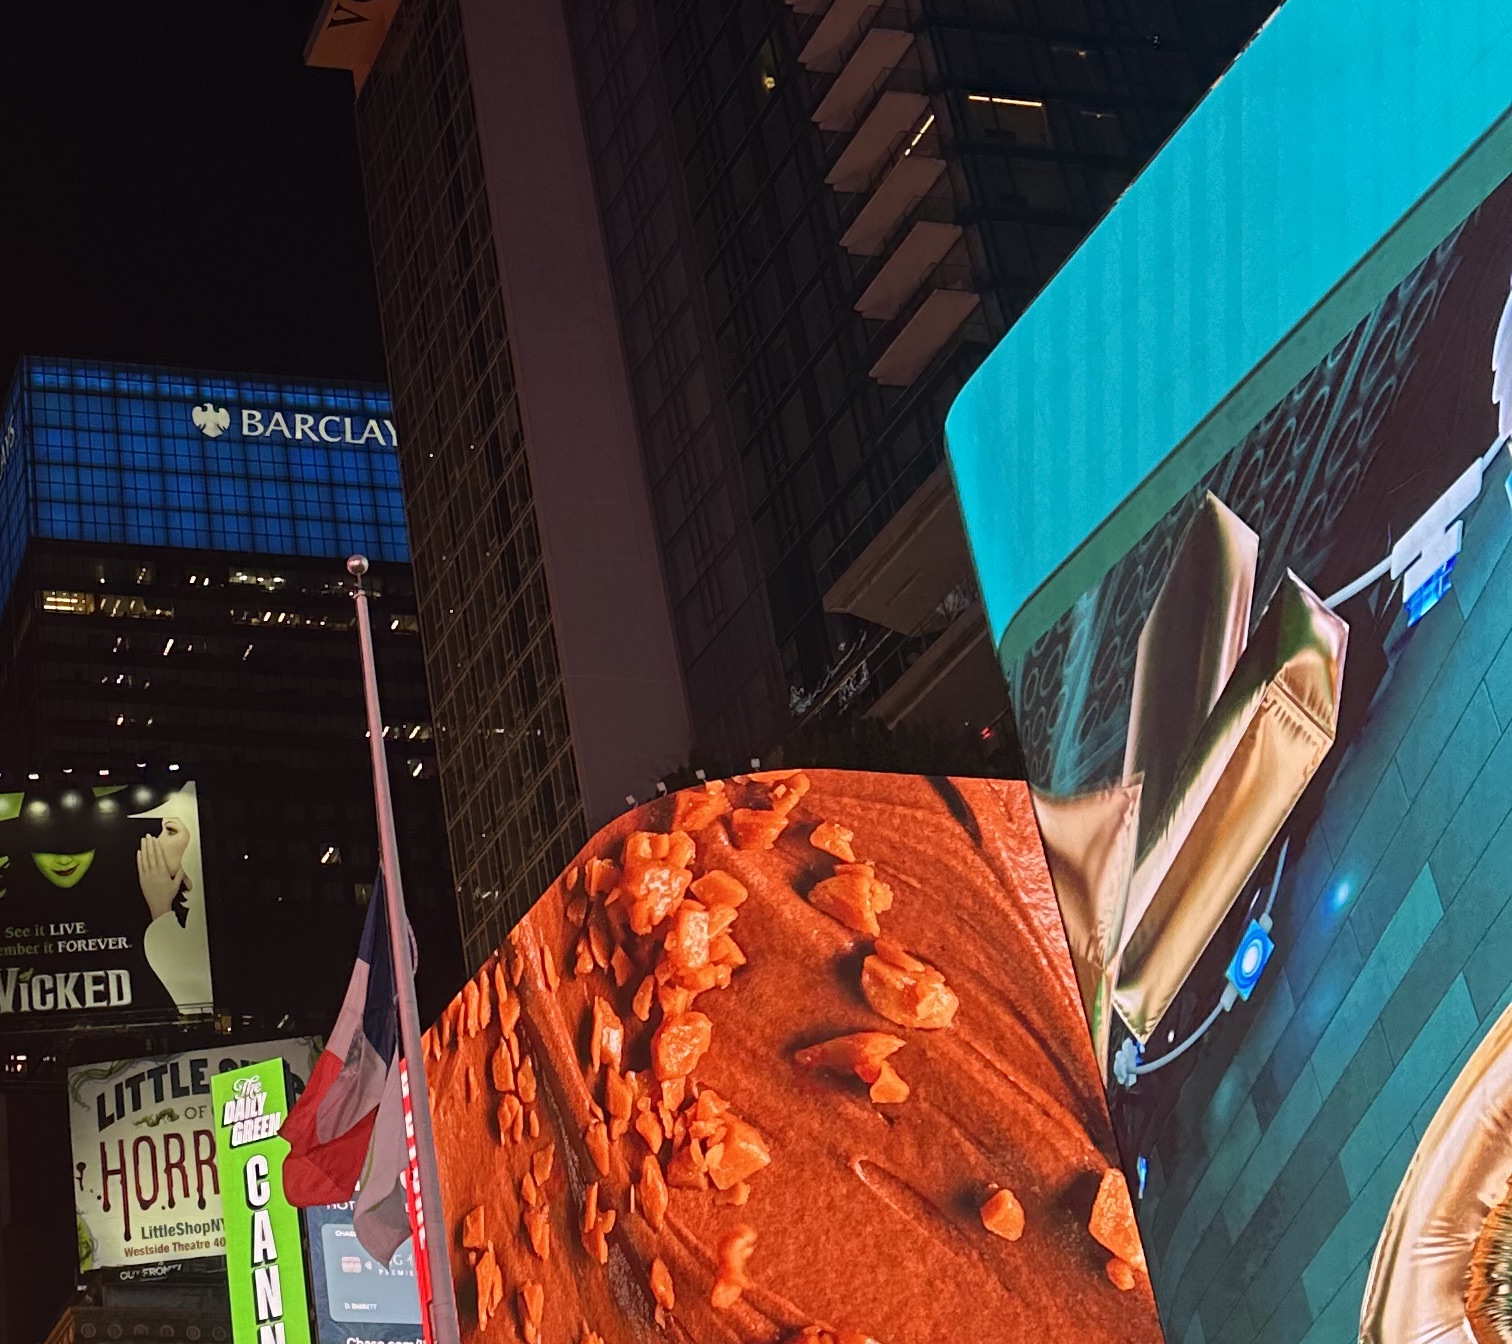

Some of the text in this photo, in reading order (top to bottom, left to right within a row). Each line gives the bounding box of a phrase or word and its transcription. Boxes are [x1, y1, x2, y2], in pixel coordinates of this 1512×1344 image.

[4, 922, 86, 940] See it LIVE
[42, 941, 54, 954] it
[96, 1059, 209, 1133] LITTLE
[233, 1075, 262, 1099] The
[184, 1105, 208, 1120] OF
[224, 1092, 268, 1126] DAILY
[231, 1112, 282, 1147] GREEN
[124, 1243, 169, 1258] Westside
[171, 1239, 210, 1254] Theatre
